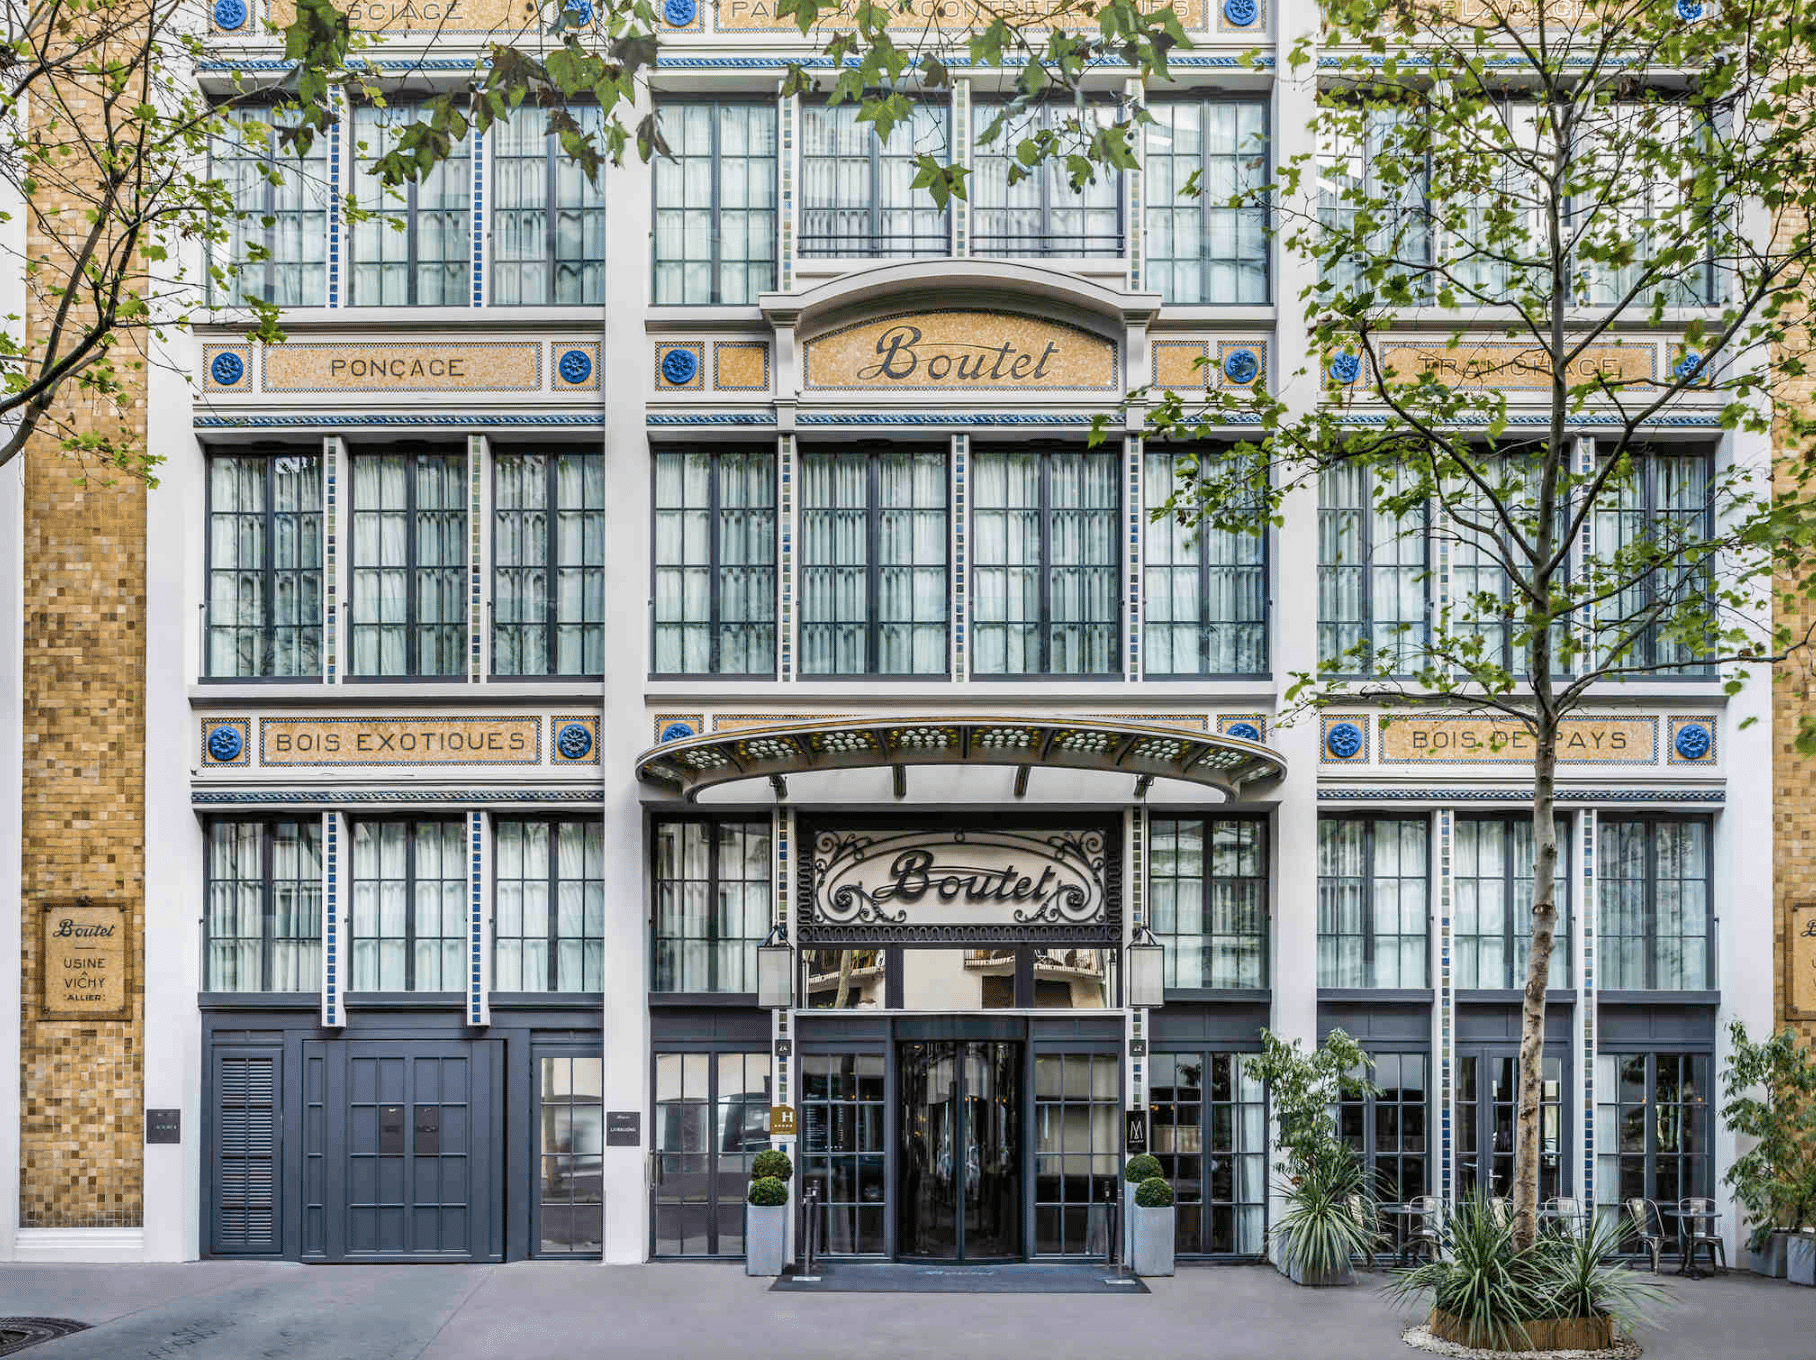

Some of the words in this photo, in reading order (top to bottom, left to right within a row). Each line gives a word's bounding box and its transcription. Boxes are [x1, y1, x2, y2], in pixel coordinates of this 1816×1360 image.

[346, 3, 463, 21] SCIAGE
[856, 325, 1060, 380] Boutet
[331, 358, 465, 379] PONÇAGE
[275, 733, 341, 751] BOIS
[356, 732, 525, 751] EXOTIQUES
[1412, 730, 1478, 749] BOIS
[871, 849, 1057, 901] Boutet
[52, 918, 116, 938] Boutet
[63, 957, 106, 969] USINE
[64, 978, 106, 988] VICHY
[782, 1111, 794, 1123] H
